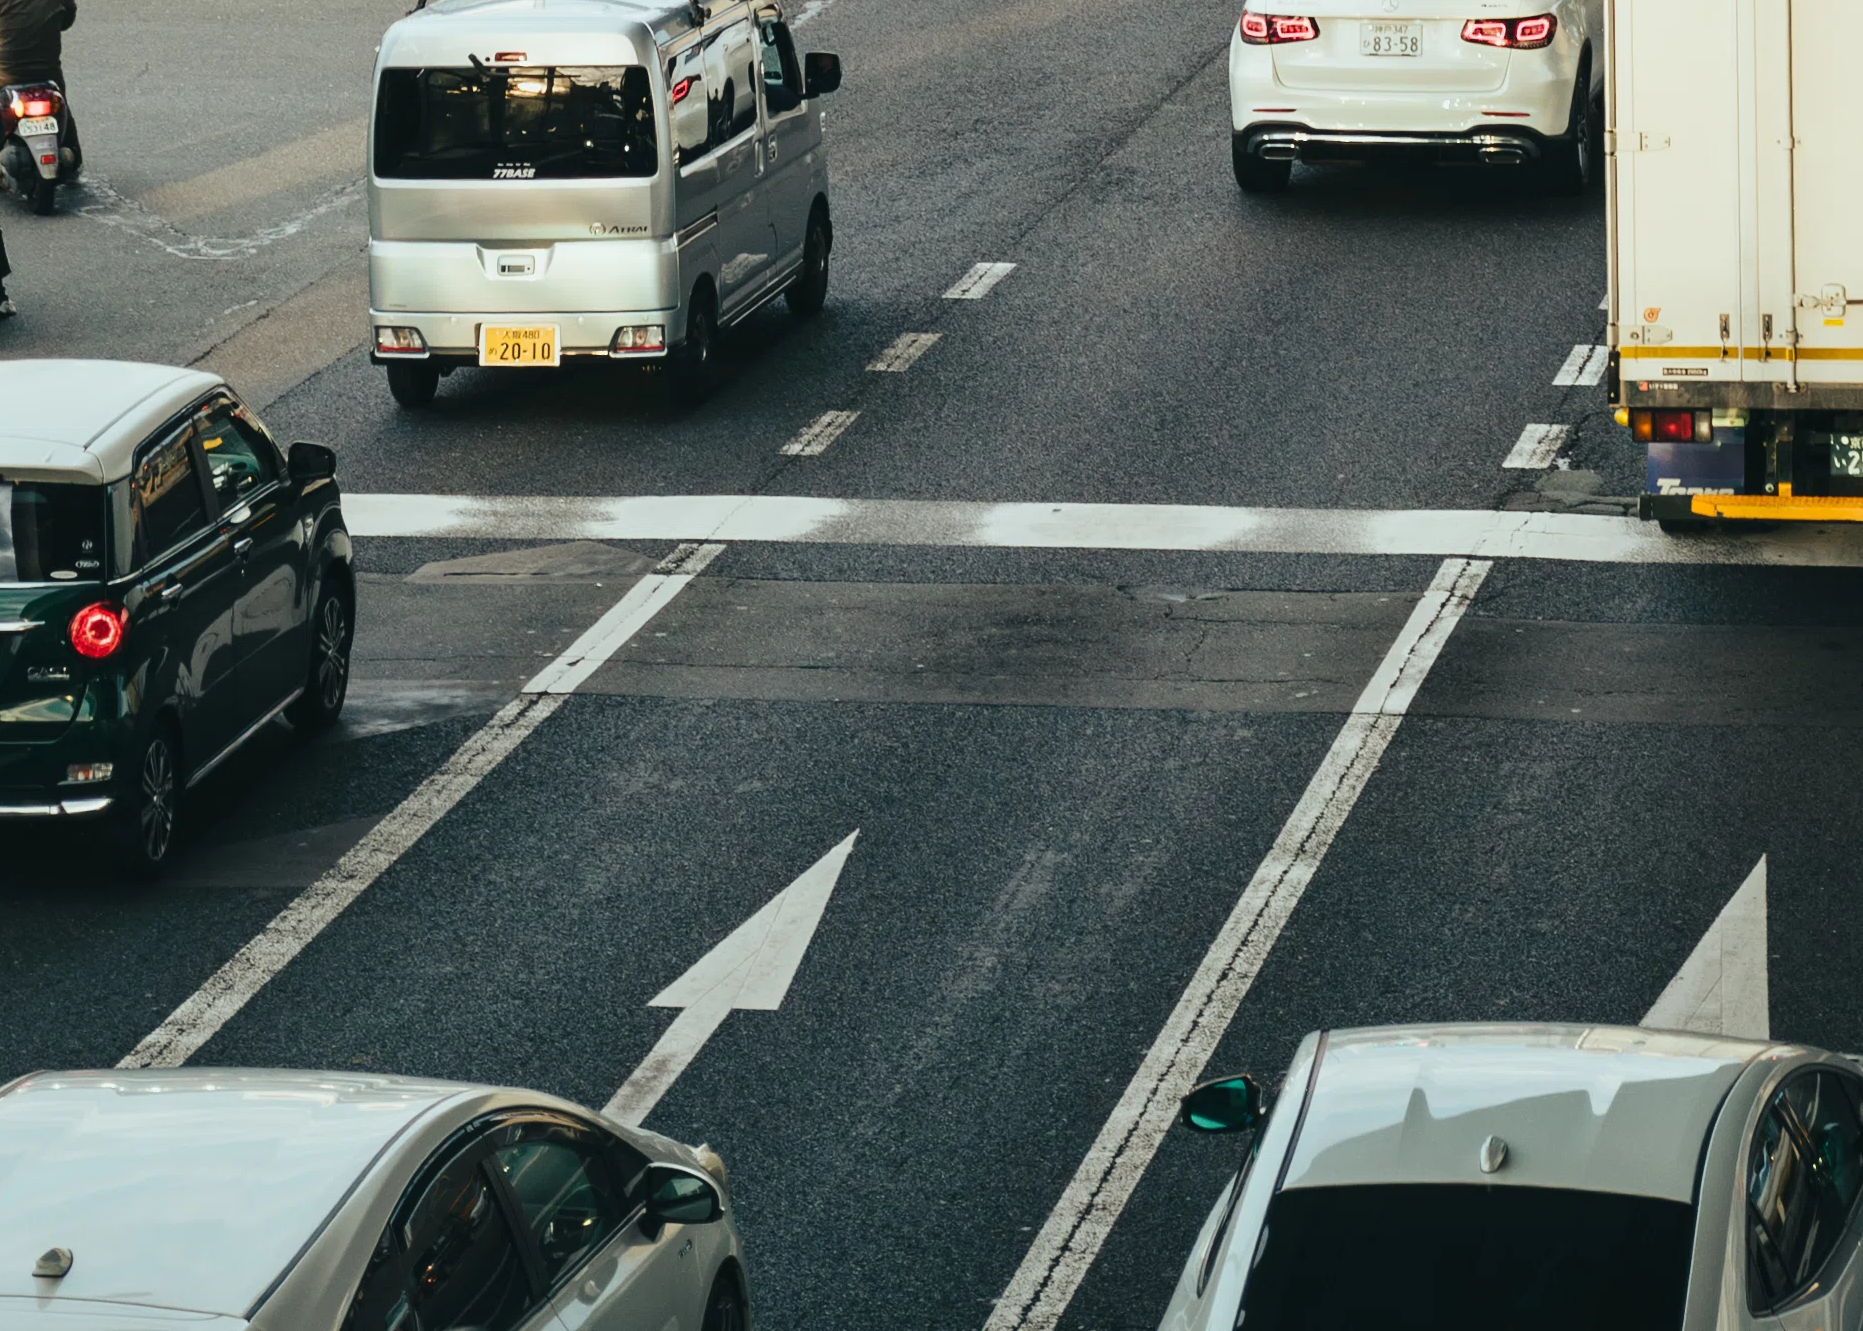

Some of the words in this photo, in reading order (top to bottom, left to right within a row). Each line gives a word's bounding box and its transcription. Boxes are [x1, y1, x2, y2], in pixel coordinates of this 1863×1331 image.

[1373, 37, 1419, 53] 83-58
[493, 168, 536, 179] 77BASE
[499, 342, 551, 361] 20-10
